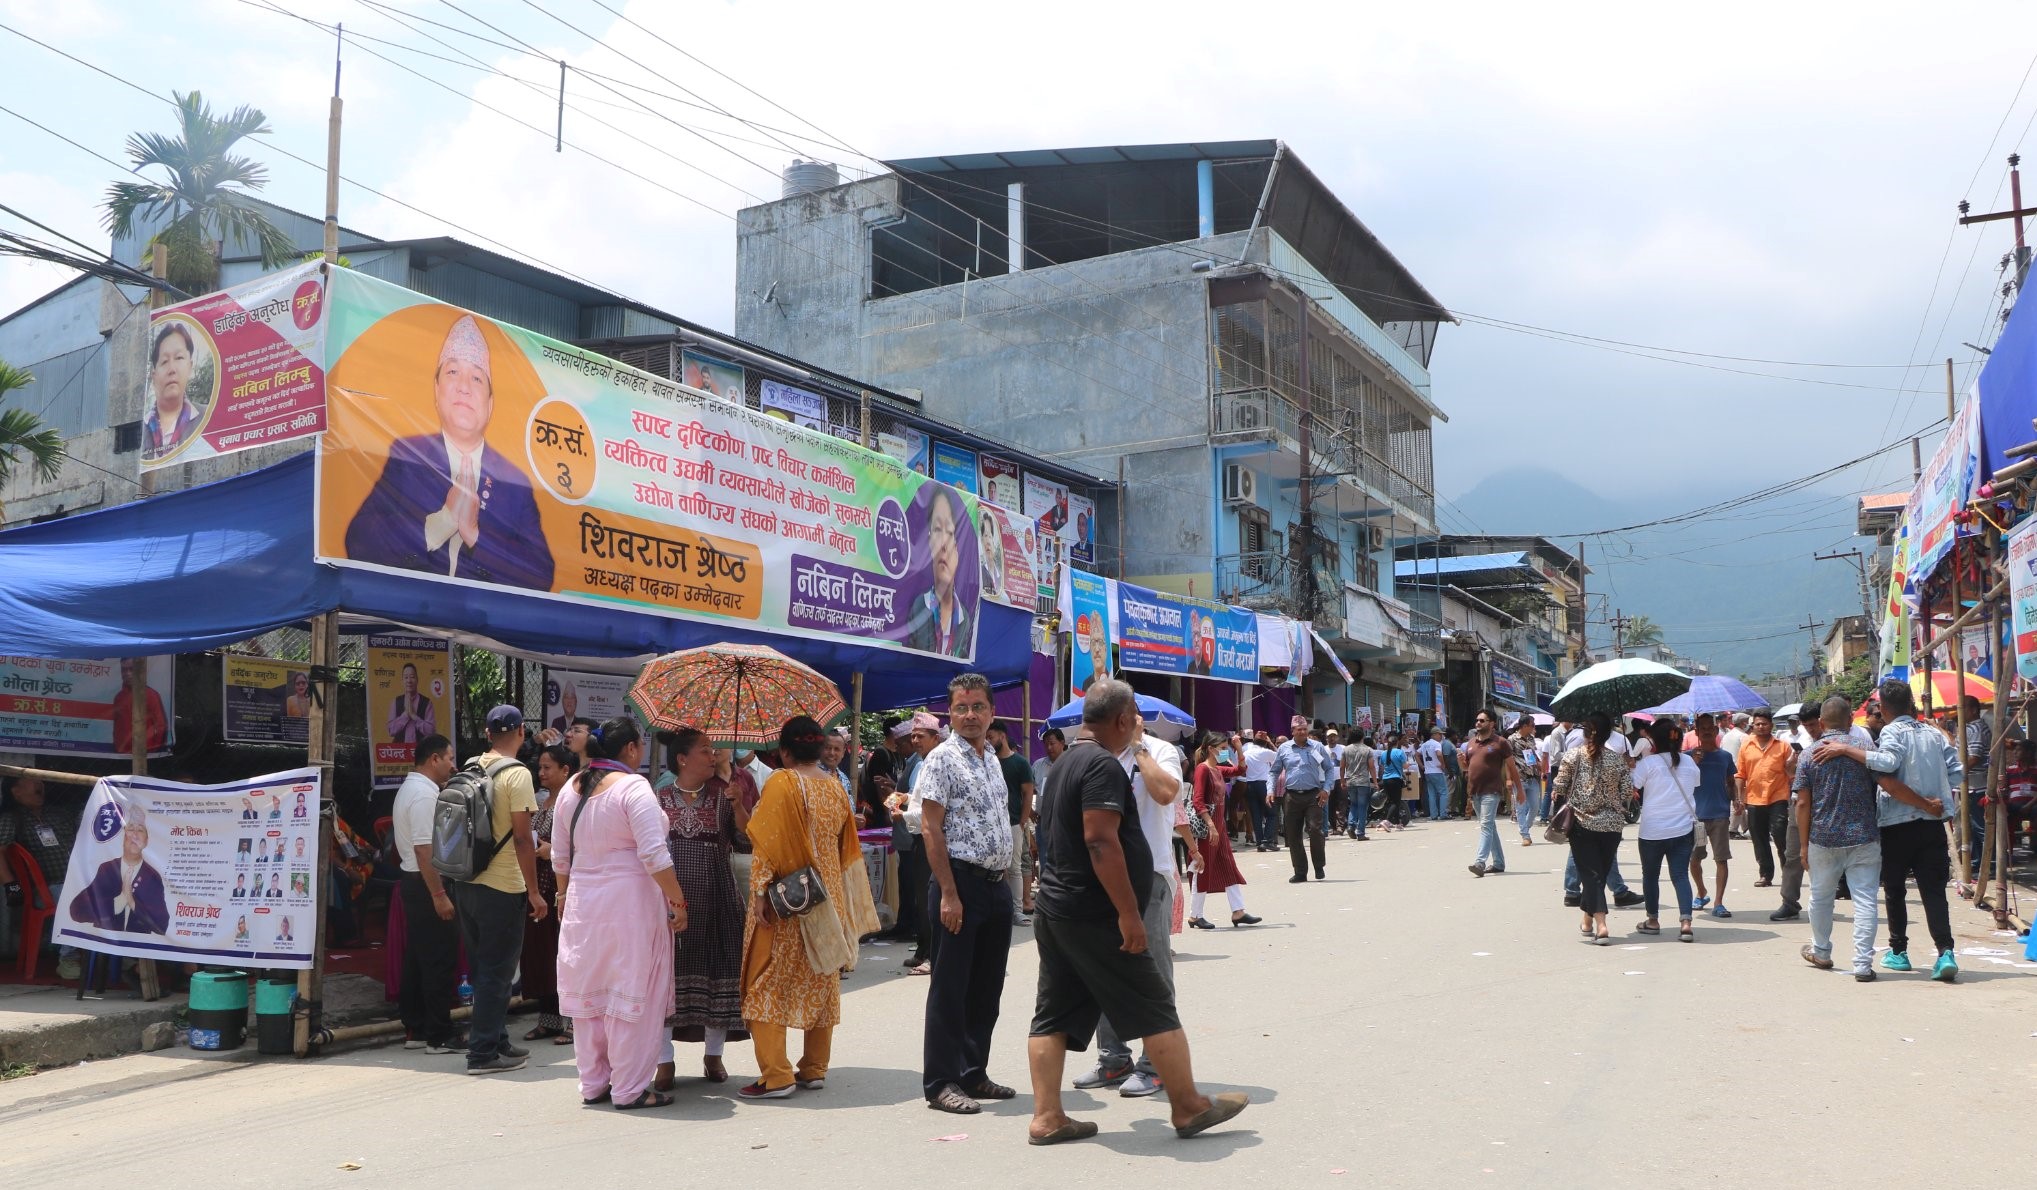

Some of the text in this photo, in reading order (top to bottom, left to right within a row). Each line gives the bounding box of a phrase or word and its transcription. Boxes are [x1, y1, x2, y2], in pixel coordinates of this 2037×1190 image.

[213, 299, 291, 334] हार्दिक अनुरोध
[233, 365, 313, 398] नबिन लिम्बु
[219, 412, 317, 449] चुनाव प्रचार प्रसार समिति
[631, 409, 673, 439] स्पष्ट
[751, 444, 774, 468] प्रष्ट
[777, 448, 808, 480] विचार
[811, 463, 856, 494] कर्मशिल
[555, 462, 573, 494] ३
[604, 439, 872, 529] व्यक्तित्व उद्यमी व्यवसायीले खोजेको सुनसरी
[632, 481, 858, 556] उद्योग वाणिज्य संघको आगामी नेतृत्व
[578, 511, 750, 584] शिवराज श्रेष्ठ
[584, 566, 746, 611] अध्यक्ष पदका उम्मेदवार
[796, 561, 897, 624] नबिन लिम्बु
[792, 598, 815, 619] वाणिज्य
[2, 673, 73, 695] भोला श्रेष्ठ
[378, 745, 407, 760] उपेन्द्र
[175, 901, 205, 918] शिवराज
